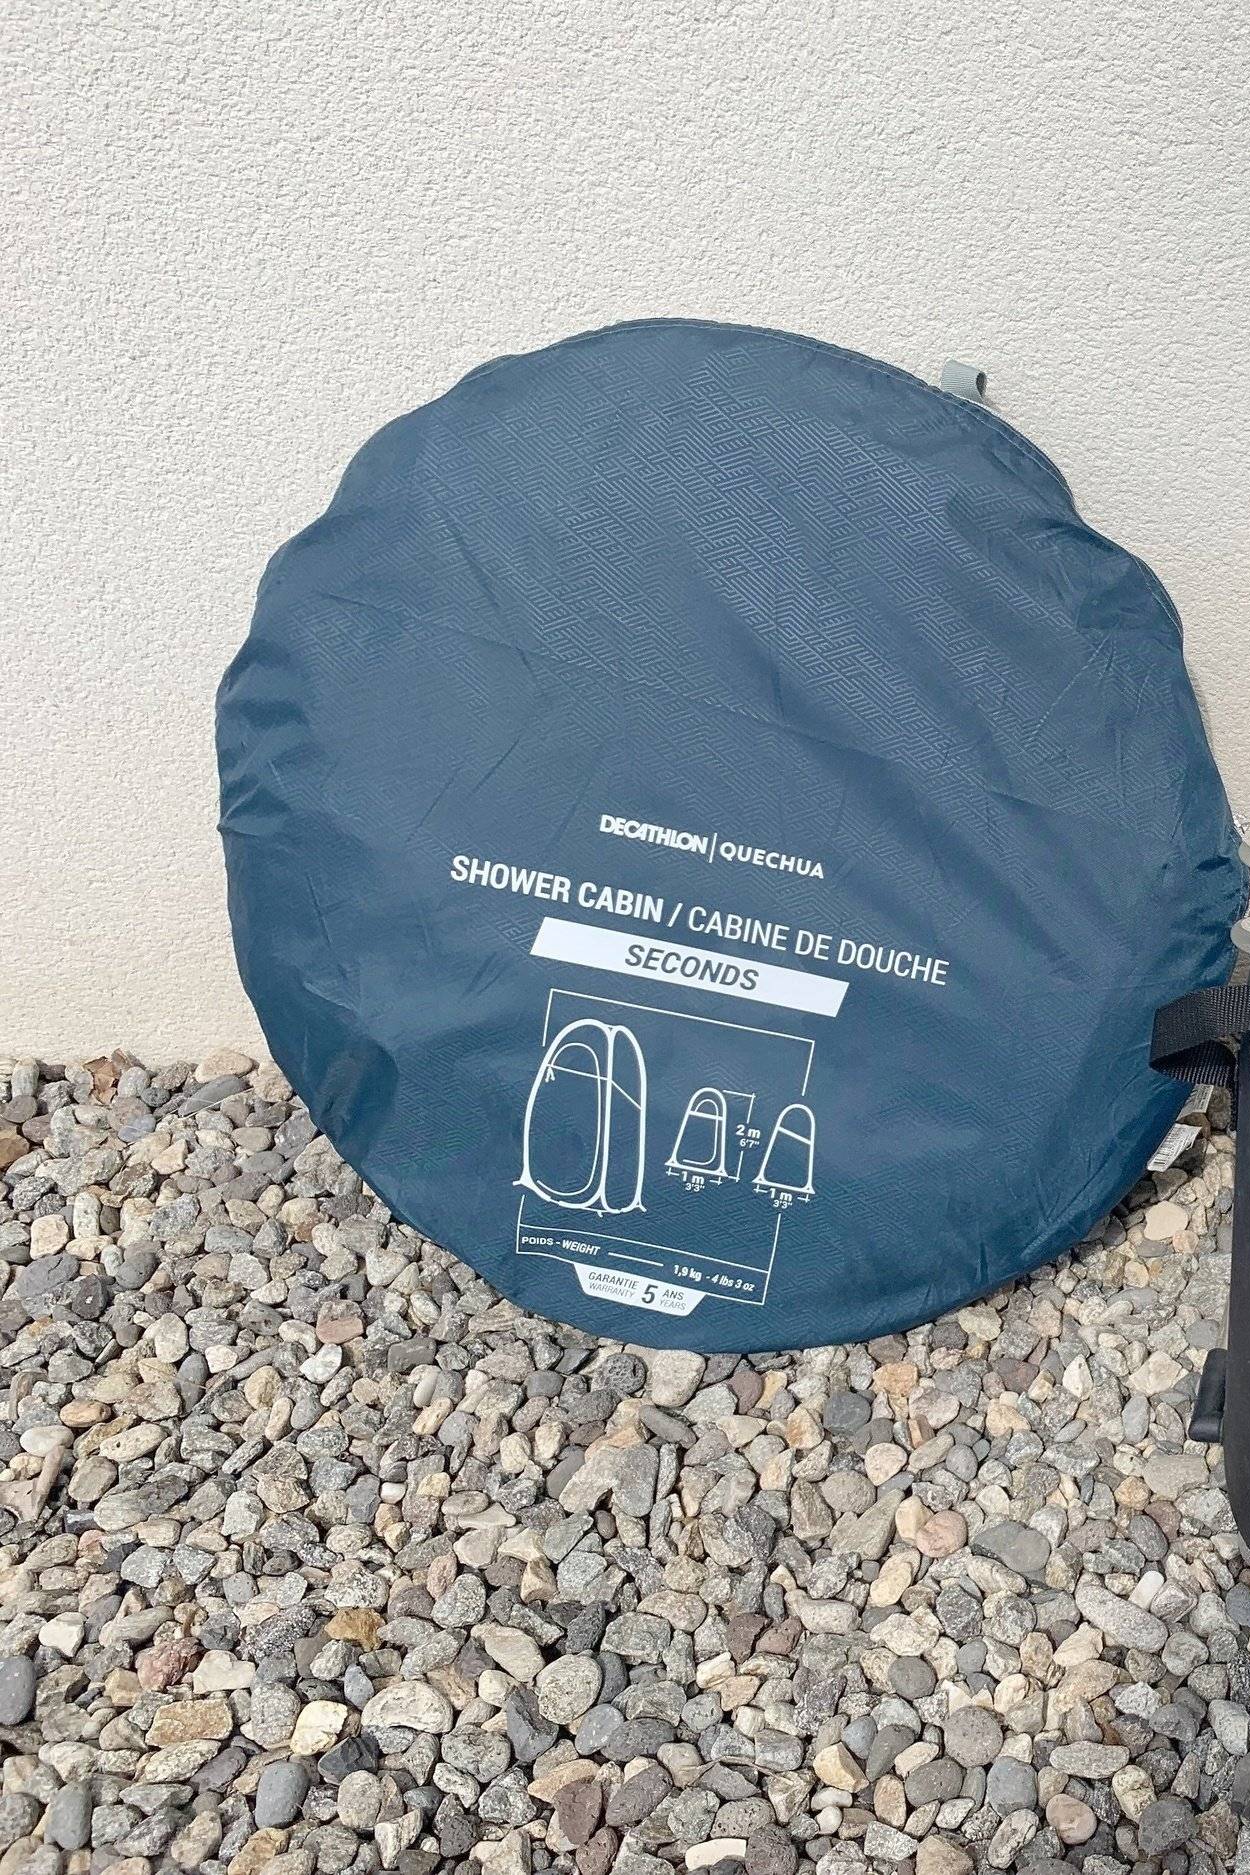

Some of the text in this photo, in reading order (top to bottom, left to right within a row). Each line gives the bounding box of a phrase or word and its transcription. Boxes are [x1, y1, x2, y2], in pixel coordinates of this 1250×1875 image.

[599, 814, 824, 879] DECATHLON QUECHUA
[450, 854, 950, 986] SHOWER CABIN / CABINE DE DOUCHE
[624, 943, 760, 992] SECONDS
[735, 1124, 761, 1139] 2 m
[681, 1170, 705, 1185] 1 m
[769, 1188, 793, 1202] 1 m
[521, 1236, 554, 1246] POIDS
[561, 1239, 600, 1256] WEIGHT
[588, 1271, 640, 1290] GARANTIE
[673, 1264, 689, 1277] 1,9
[689, 1268, 703, 1282] kg
[711, 1274, 720, 1284] 4
[719, 1275, 735, 1287] lbs
[735, 1279, 743, 1289] 3
[743, 1282, 756, 1292] oz
[588, 1281, 636, 1299] WARRANTY
[641, 1283, 659, 1304] 5
[662, 1288, 685, 1302] ANS
[659, 1299, 687, 1311] YEARS
